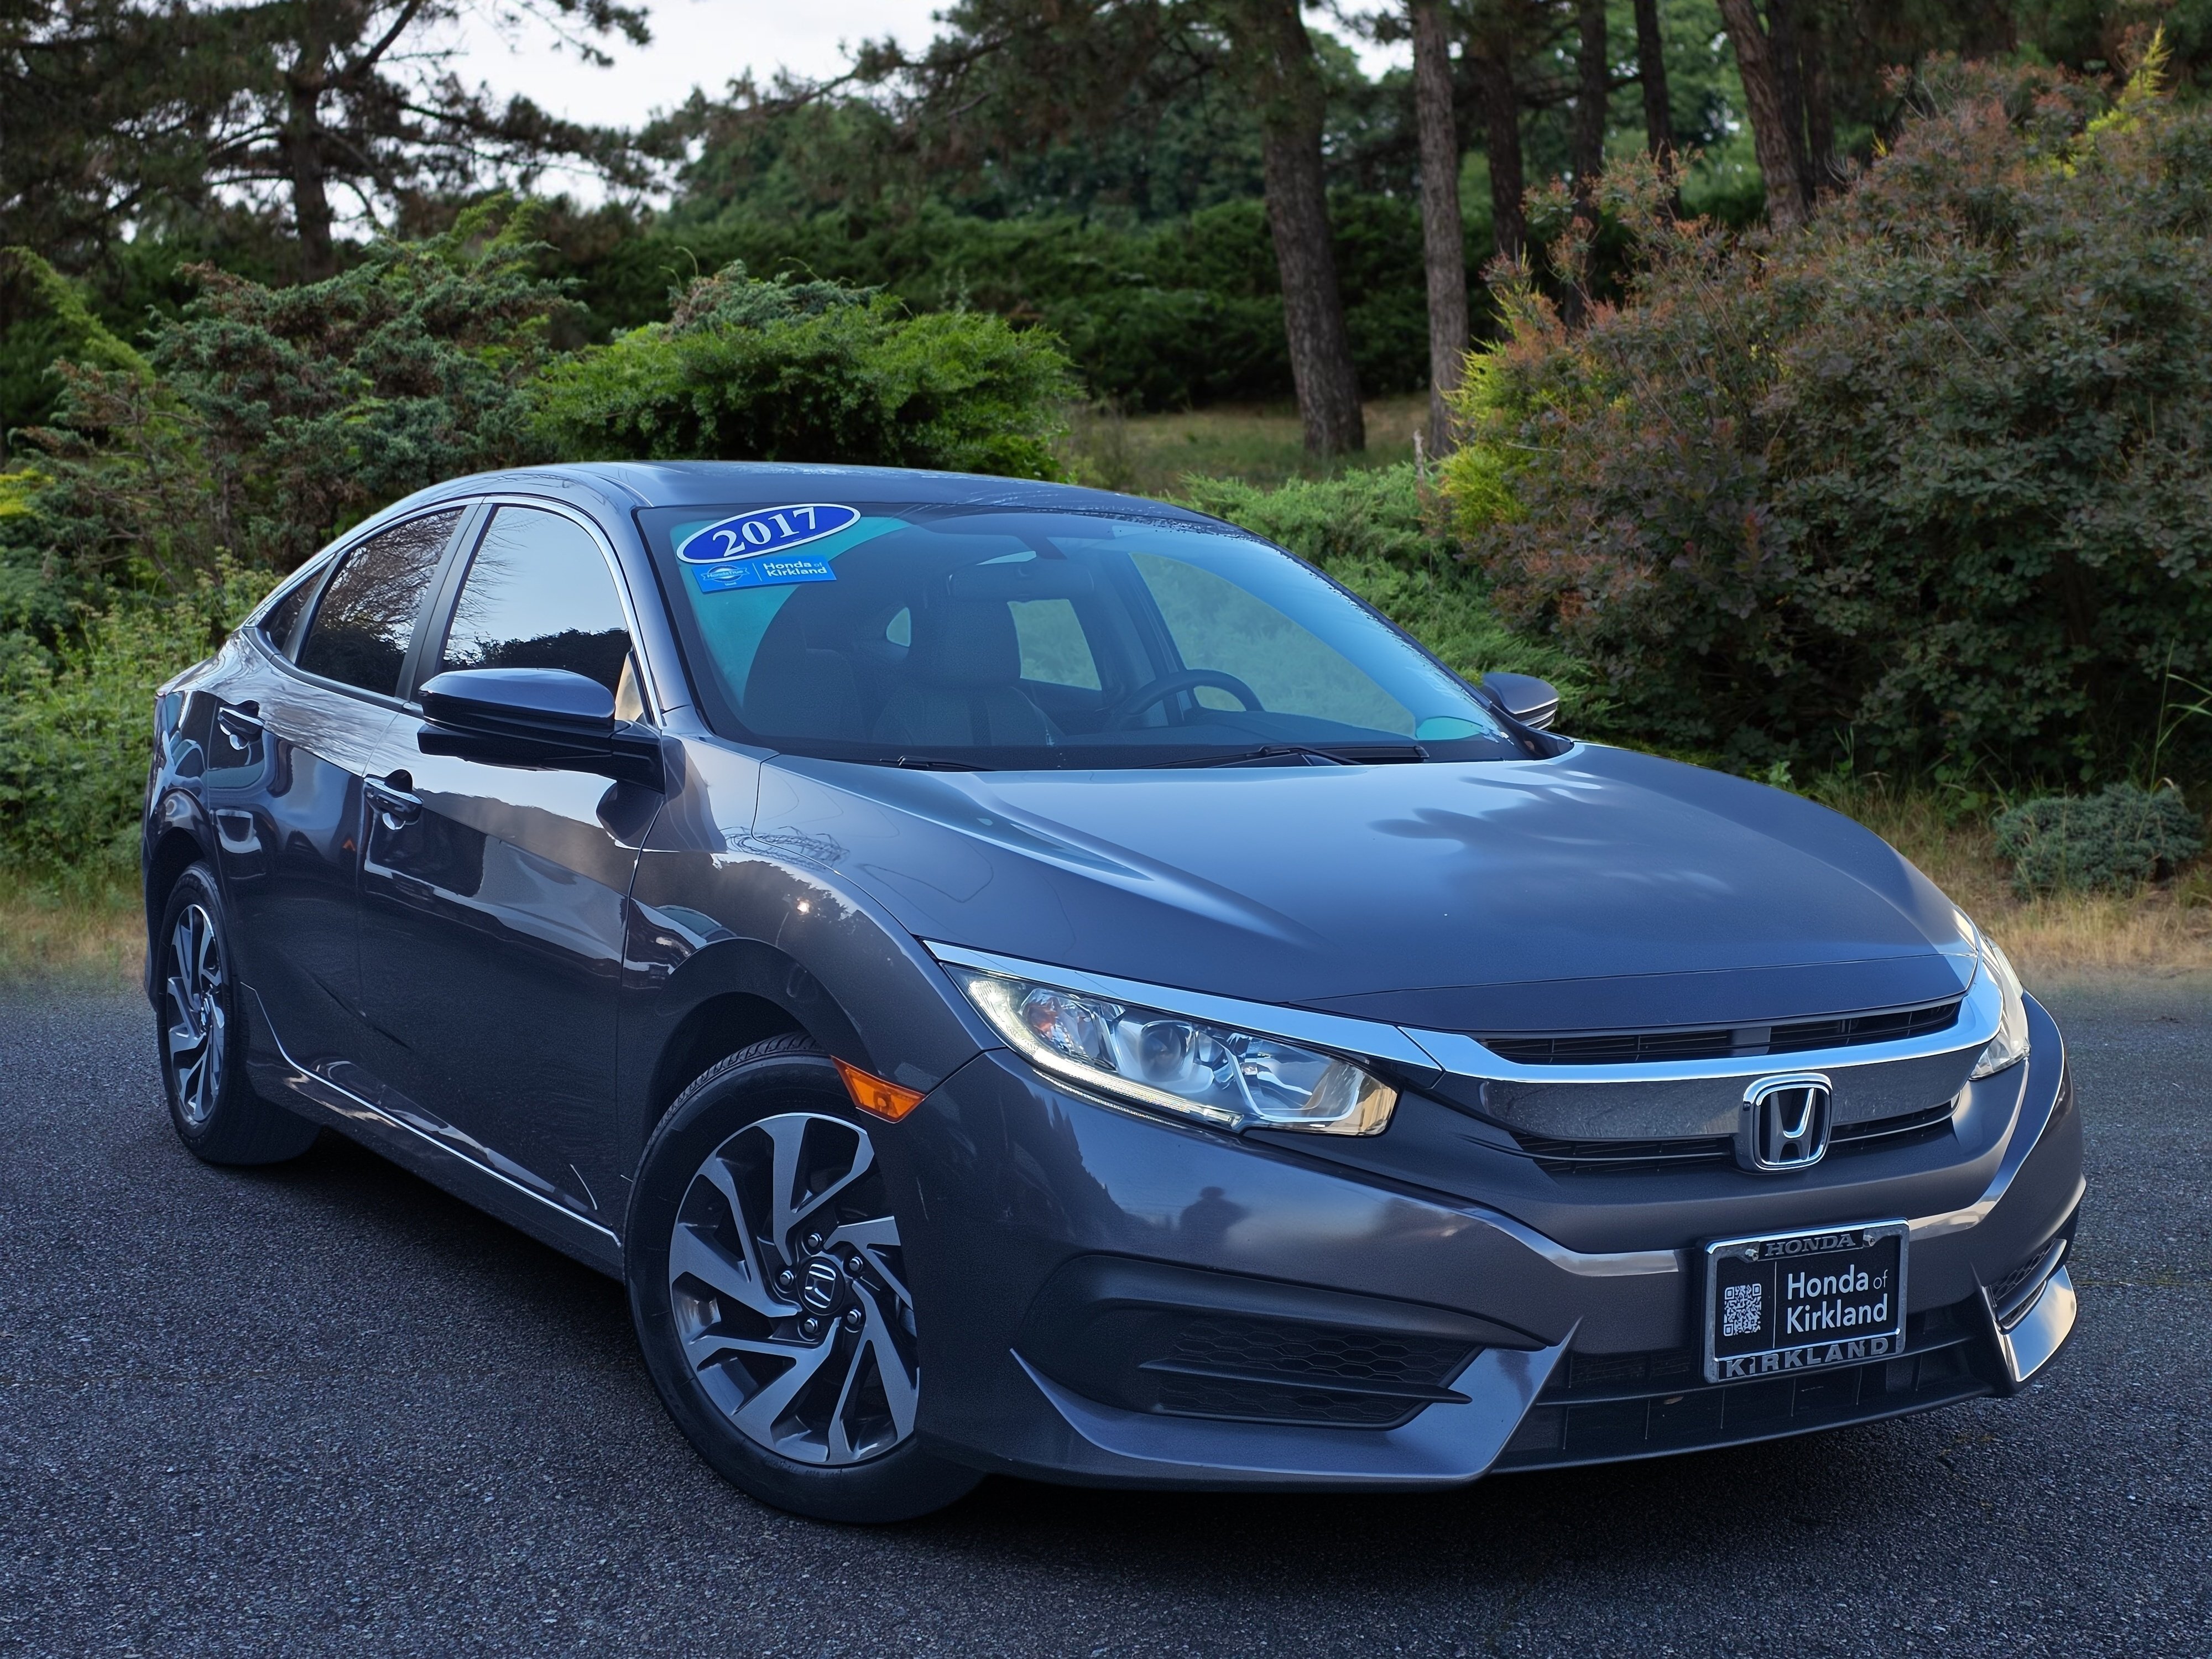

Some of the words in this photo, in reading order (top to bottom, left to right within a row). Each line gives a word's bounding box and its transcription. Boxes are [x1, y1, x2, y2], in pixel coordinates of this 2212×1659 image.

[712, 507, 816, 557] 2017
[763, 561, 812, 570] Honda
[766, 566, 827, 577] Kirkland
[1764, 1234, 1856, 1256] HONDA
[1787, 1264, 1869, 1300] Honda
[1872, 1269, 1888, 1289] of
[1787, 1293, 1888, 1334] Kirkland
[1726, 1337, 1889, 1378] KIRKLAND
